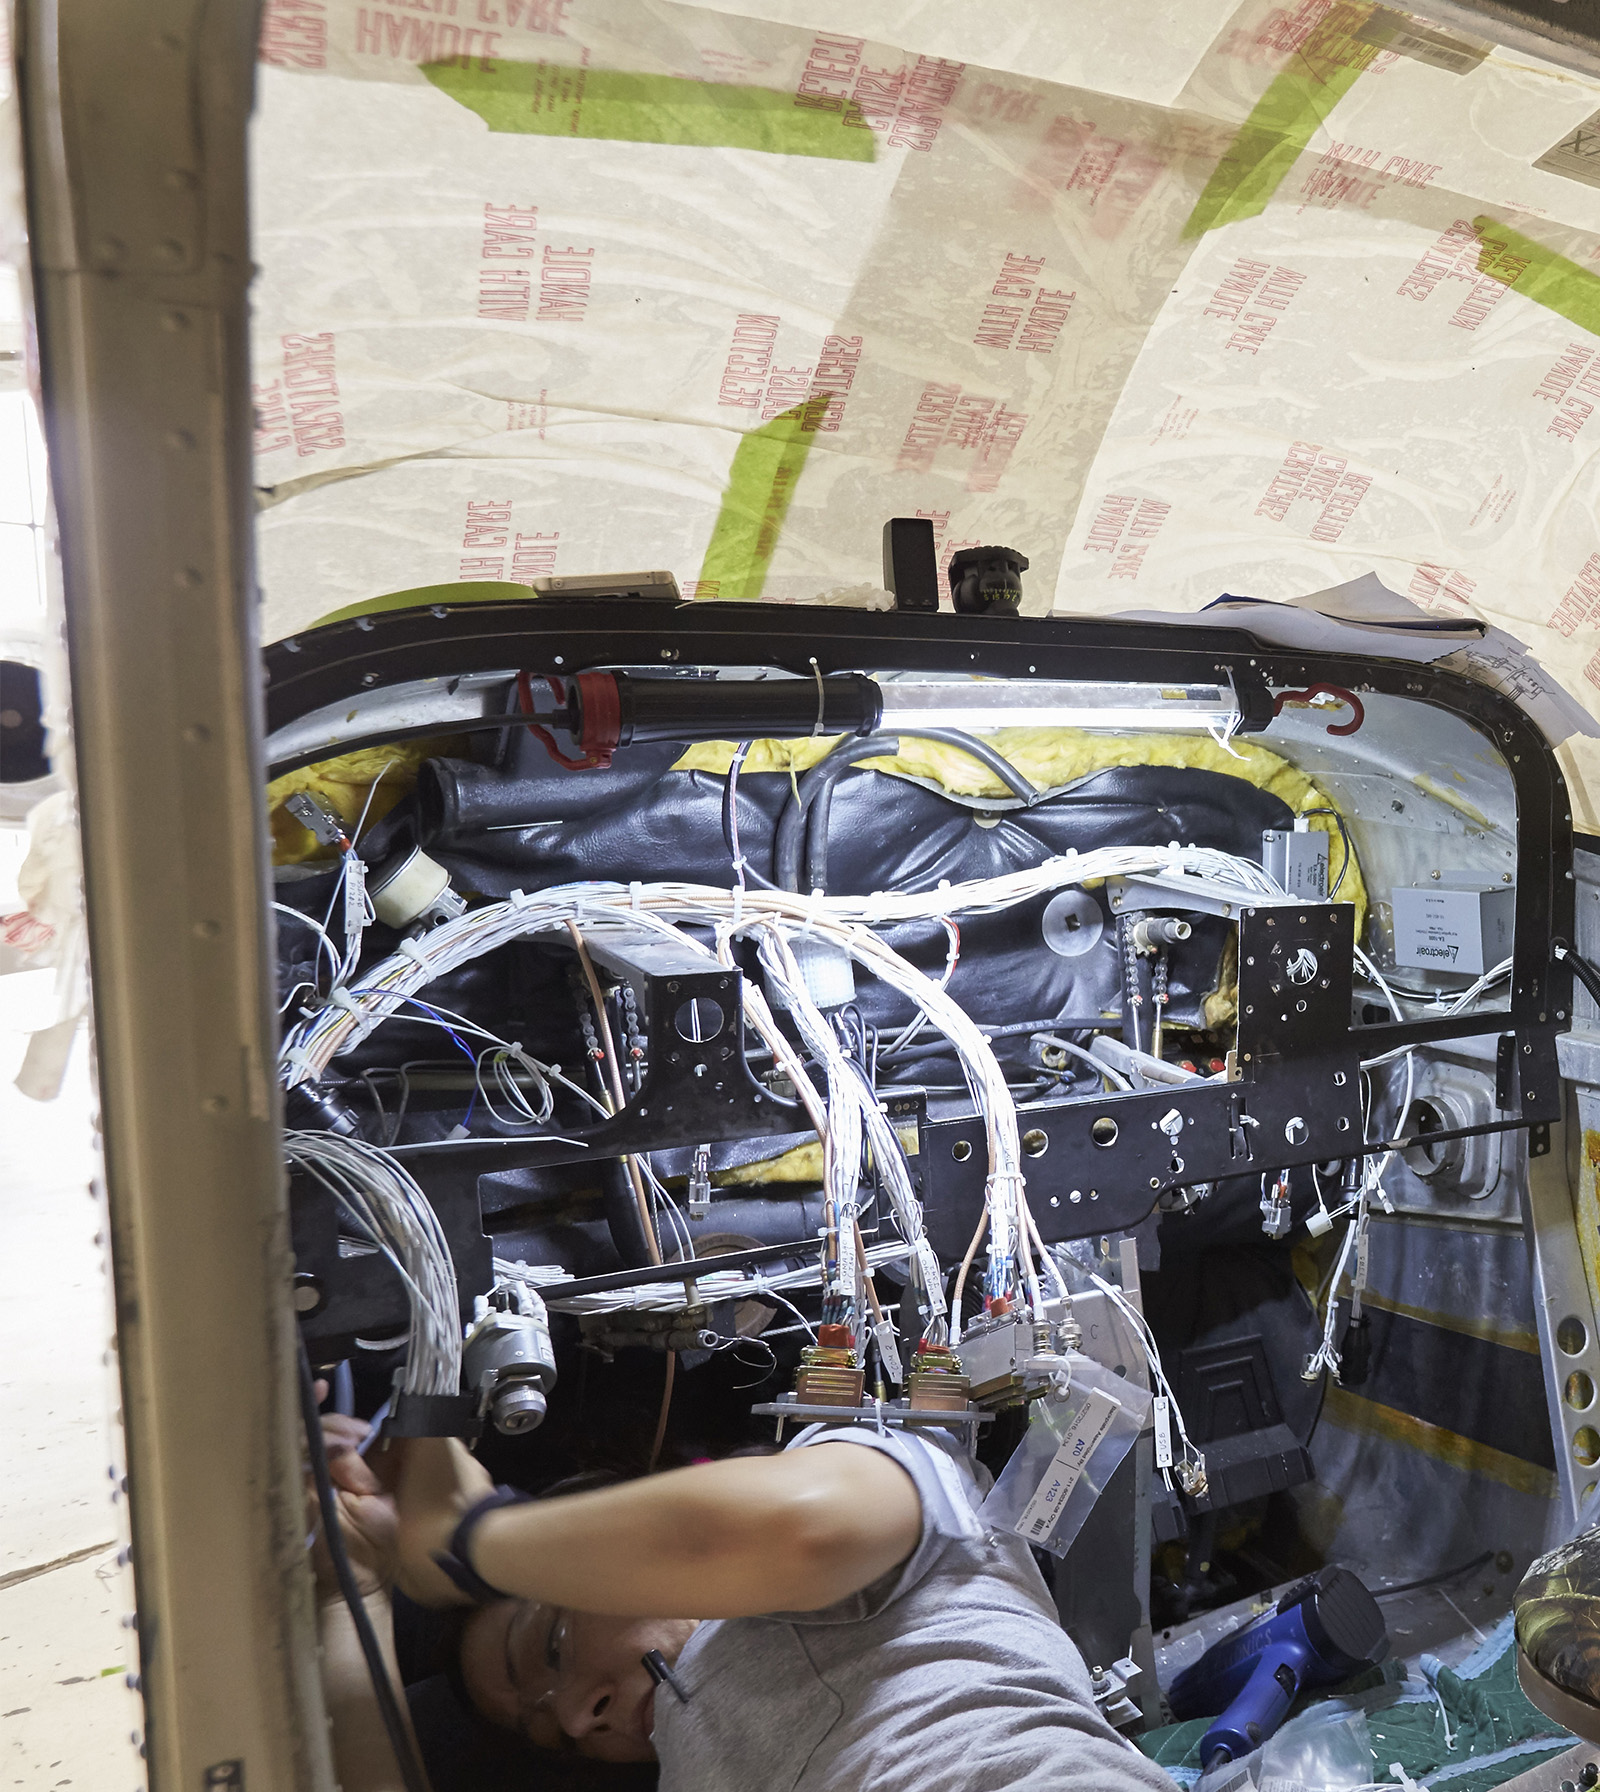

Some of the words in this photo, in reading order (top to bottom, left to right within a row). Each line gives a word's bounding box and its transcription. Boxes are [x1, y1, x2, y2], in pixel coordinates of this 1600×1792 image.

[1416, 946, 1450, 959] electroair
[1069, 1437, 1087, 1458] A70
[1158, 1432, 1167, 1450] USB
[1043, 1478, 1062, 1503] A123
